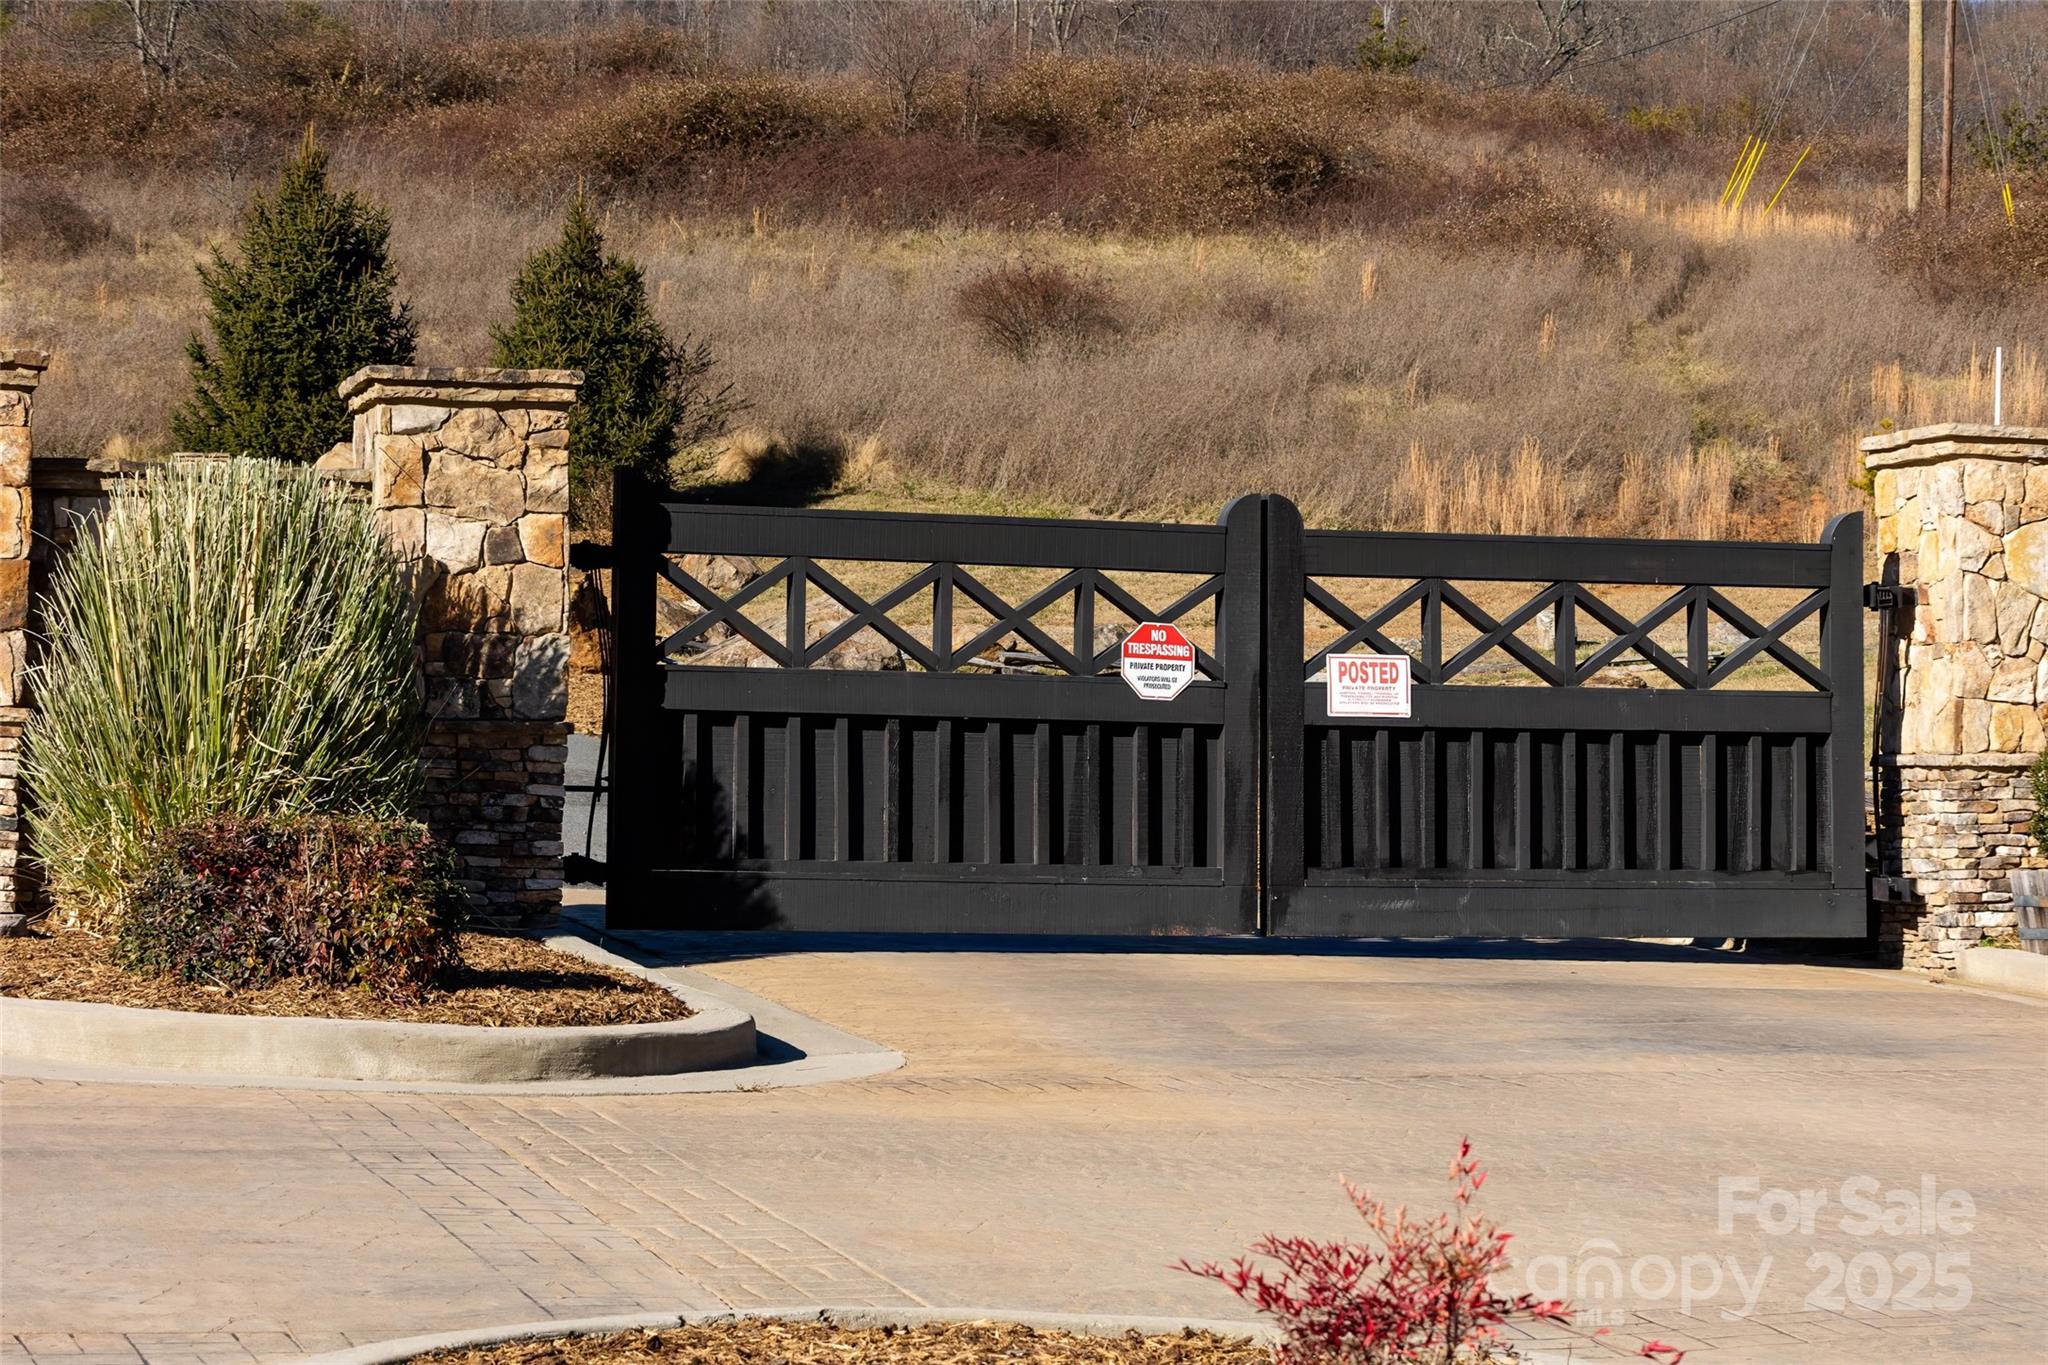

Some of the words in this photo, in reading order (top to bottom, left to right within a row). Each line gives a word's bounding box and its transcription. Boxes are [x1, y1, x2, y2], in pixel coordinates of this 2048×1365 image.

[1151, 630, 1166, 642] NO
[1127, 643, 1190, 656] TRESPASSING
[1130, 662, 1154, 670] PRIVATE
[1155, 663, 1186, 672] PROPERTY
[1338, 661, 1399, 684] POSTED
